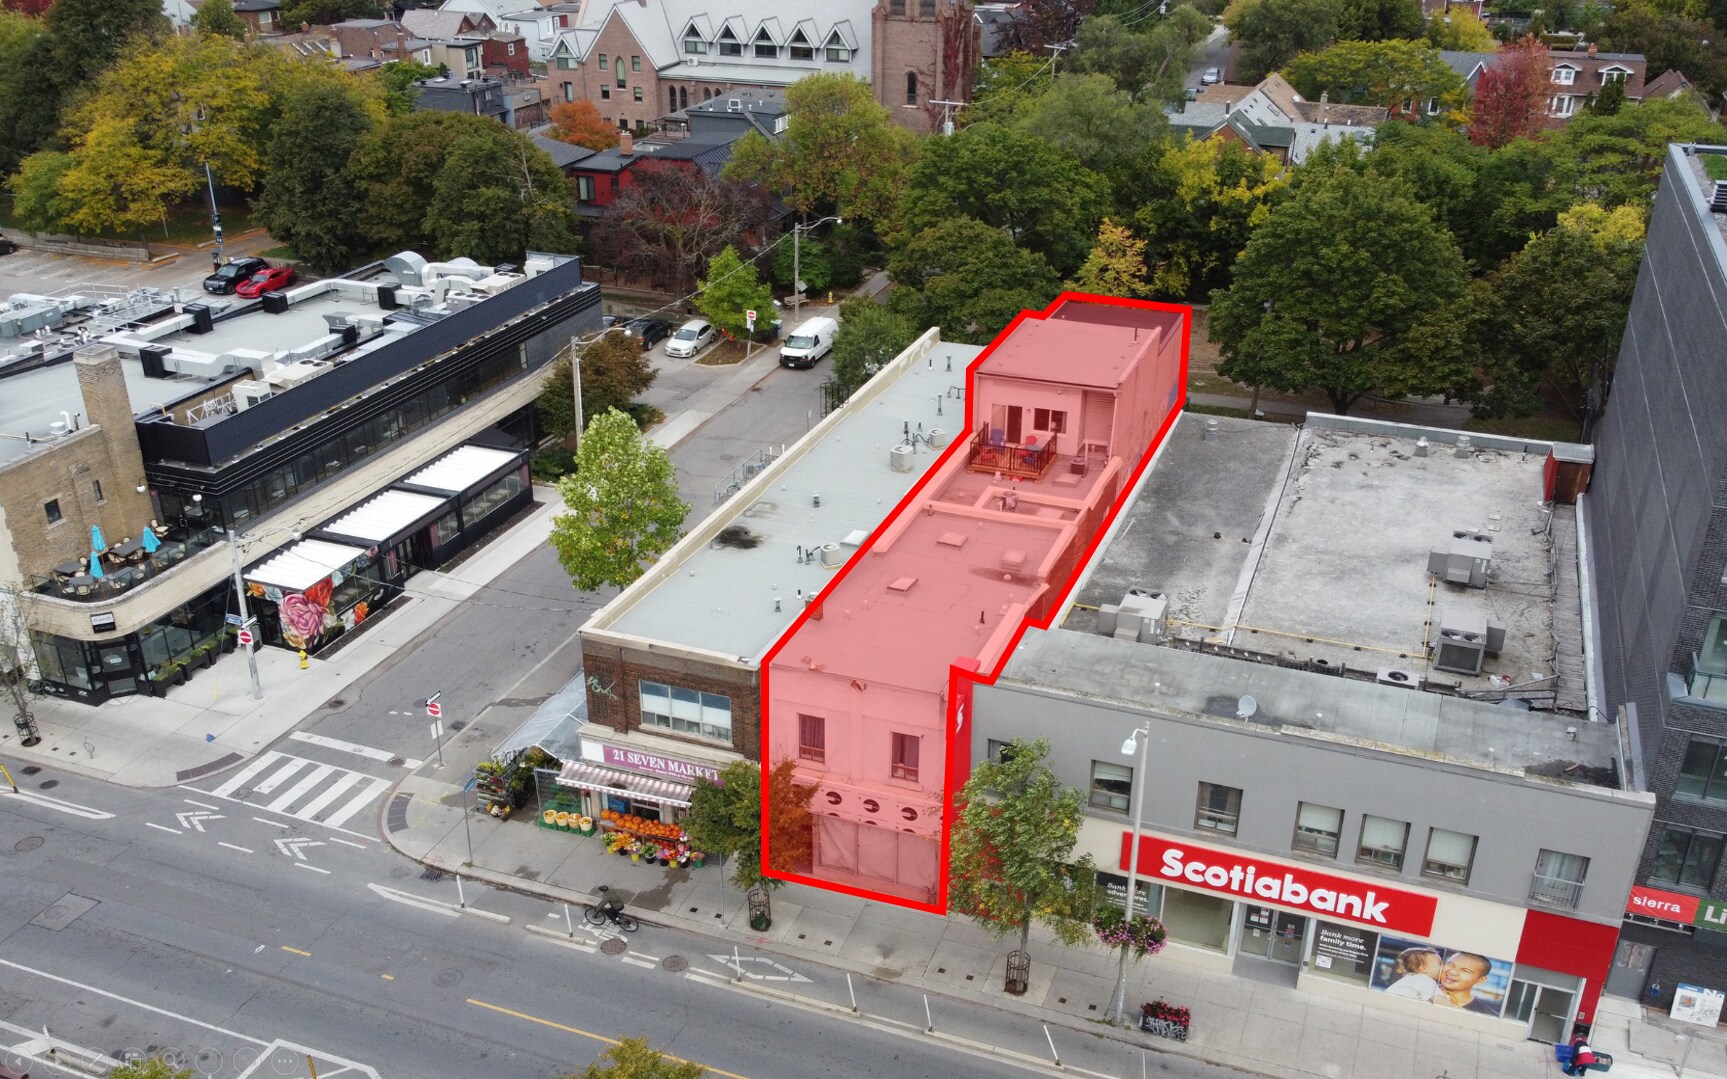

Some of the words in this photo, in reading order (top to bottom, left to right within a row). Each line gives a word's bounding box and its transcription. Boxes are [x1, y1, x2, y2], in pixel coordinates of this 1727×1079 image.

[613, 749, 625, 761] 21
[627, 752, 665, 770] SEVEN
[668, 761, 720, 781] MARKET
[1107, 882, 1127, 891] Bank
[1160, 849, 1389, 923] Scotiabank
[1633, 896, 1681, 913] sierra
[1320, 935, 1345, 946] family
[1346, 941, 1366, 951] time.
[1321, 930, 1342, 939] Bank
[1343, 934, 1365, 944] more
